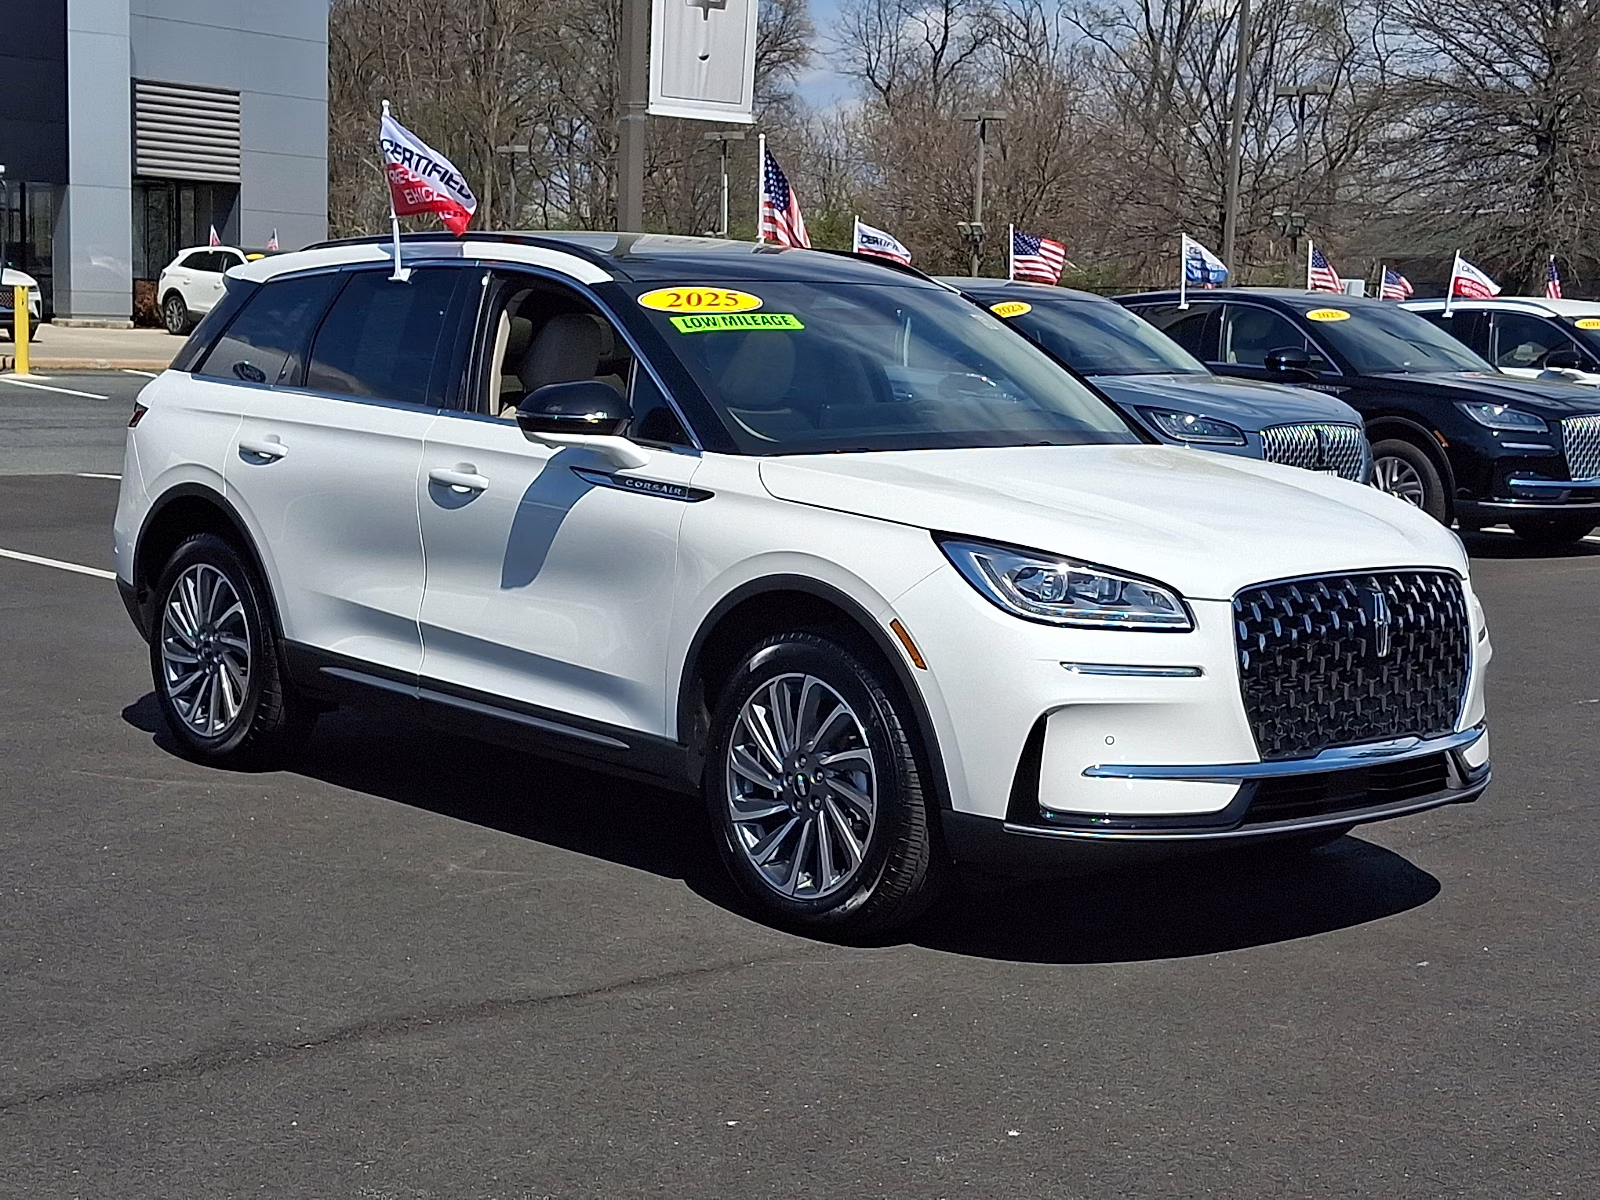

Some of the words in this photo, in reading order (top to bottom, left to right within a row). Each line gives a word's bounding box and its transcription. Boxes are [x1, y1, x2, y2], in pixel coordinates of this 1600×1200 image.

[666, 292, 739, 308] 2025
[682, 316, 717, 329] LOW
[721, 314, 792, 327] MILEAGE
[625, 479, 682, 496] CORSAIR
